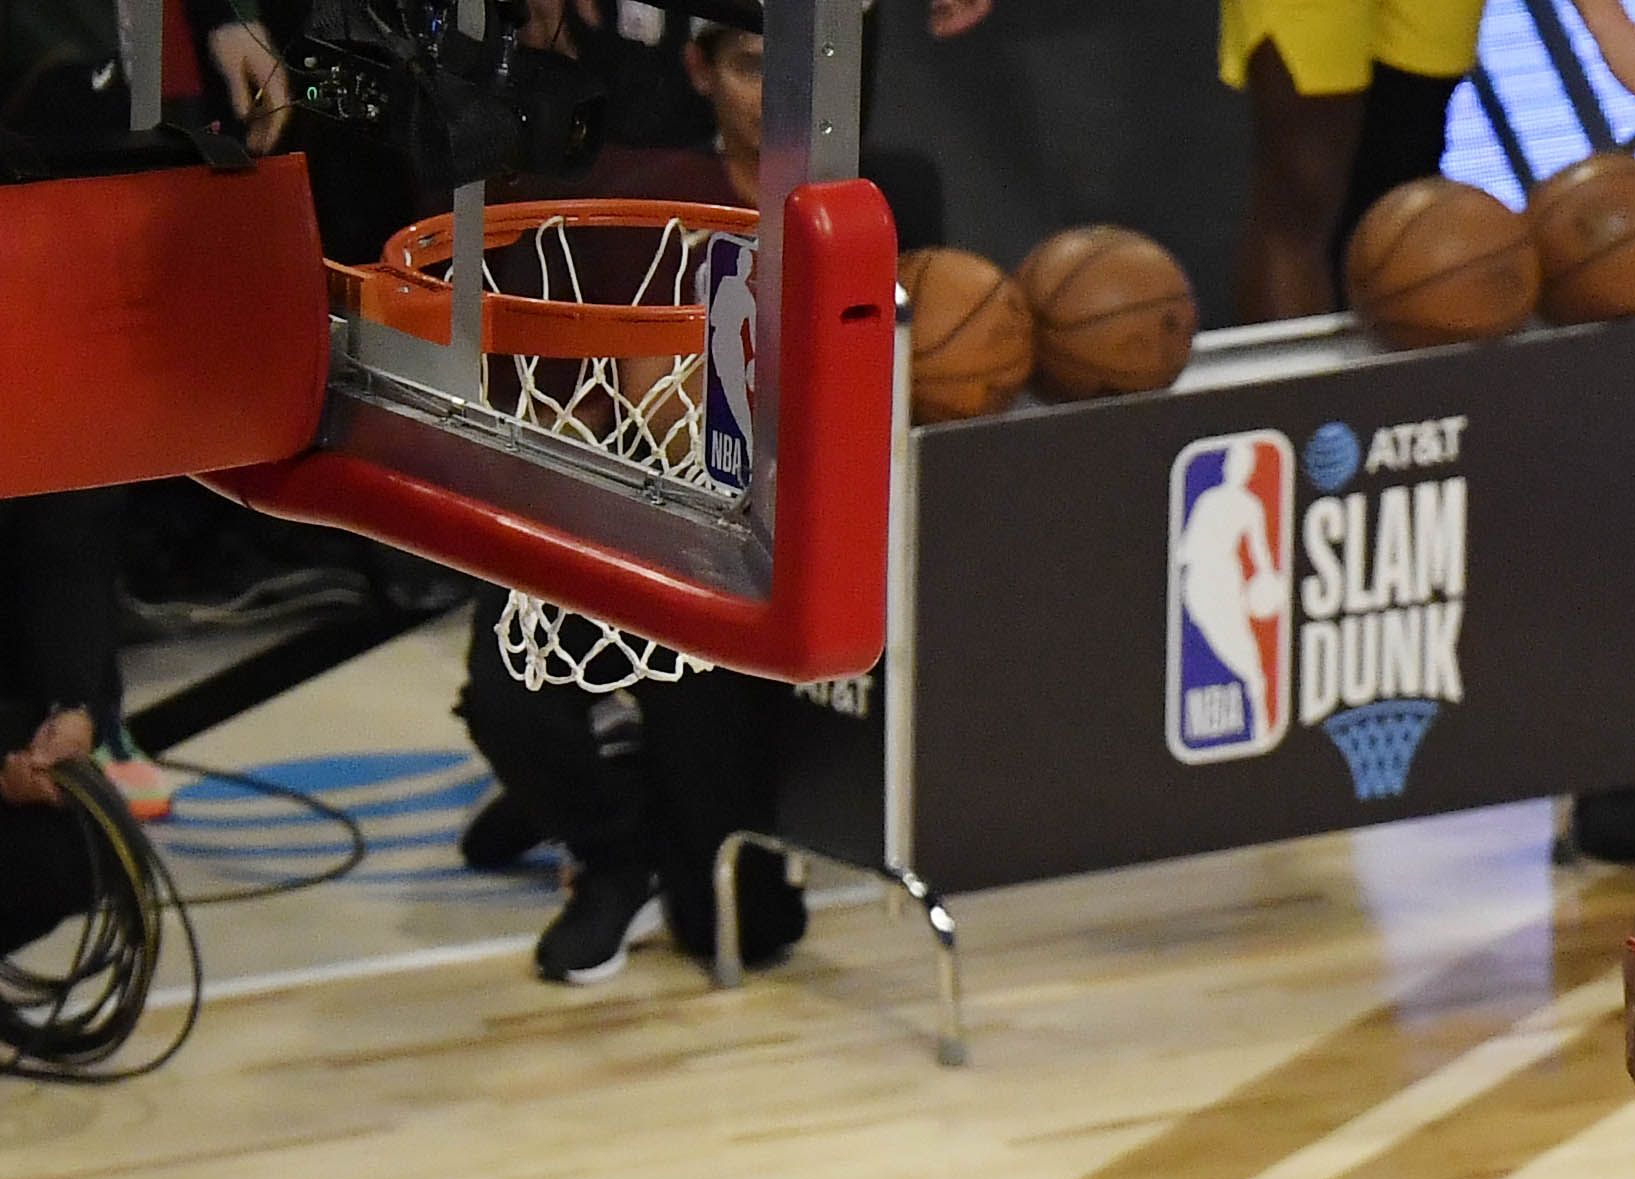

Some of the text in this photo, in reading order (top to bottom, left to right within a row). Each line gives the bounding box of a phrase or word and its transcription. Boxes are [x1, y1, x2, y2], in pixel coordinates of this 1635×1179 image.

[711, 430, 743, 483] NBA
[1364, 414, 1468, 474] AT&T
[1301, 475, 1467, 620] SLAM
[1299, 602, 1464, 726] DUNK
[1184, 682, 1245, 737] NBA
